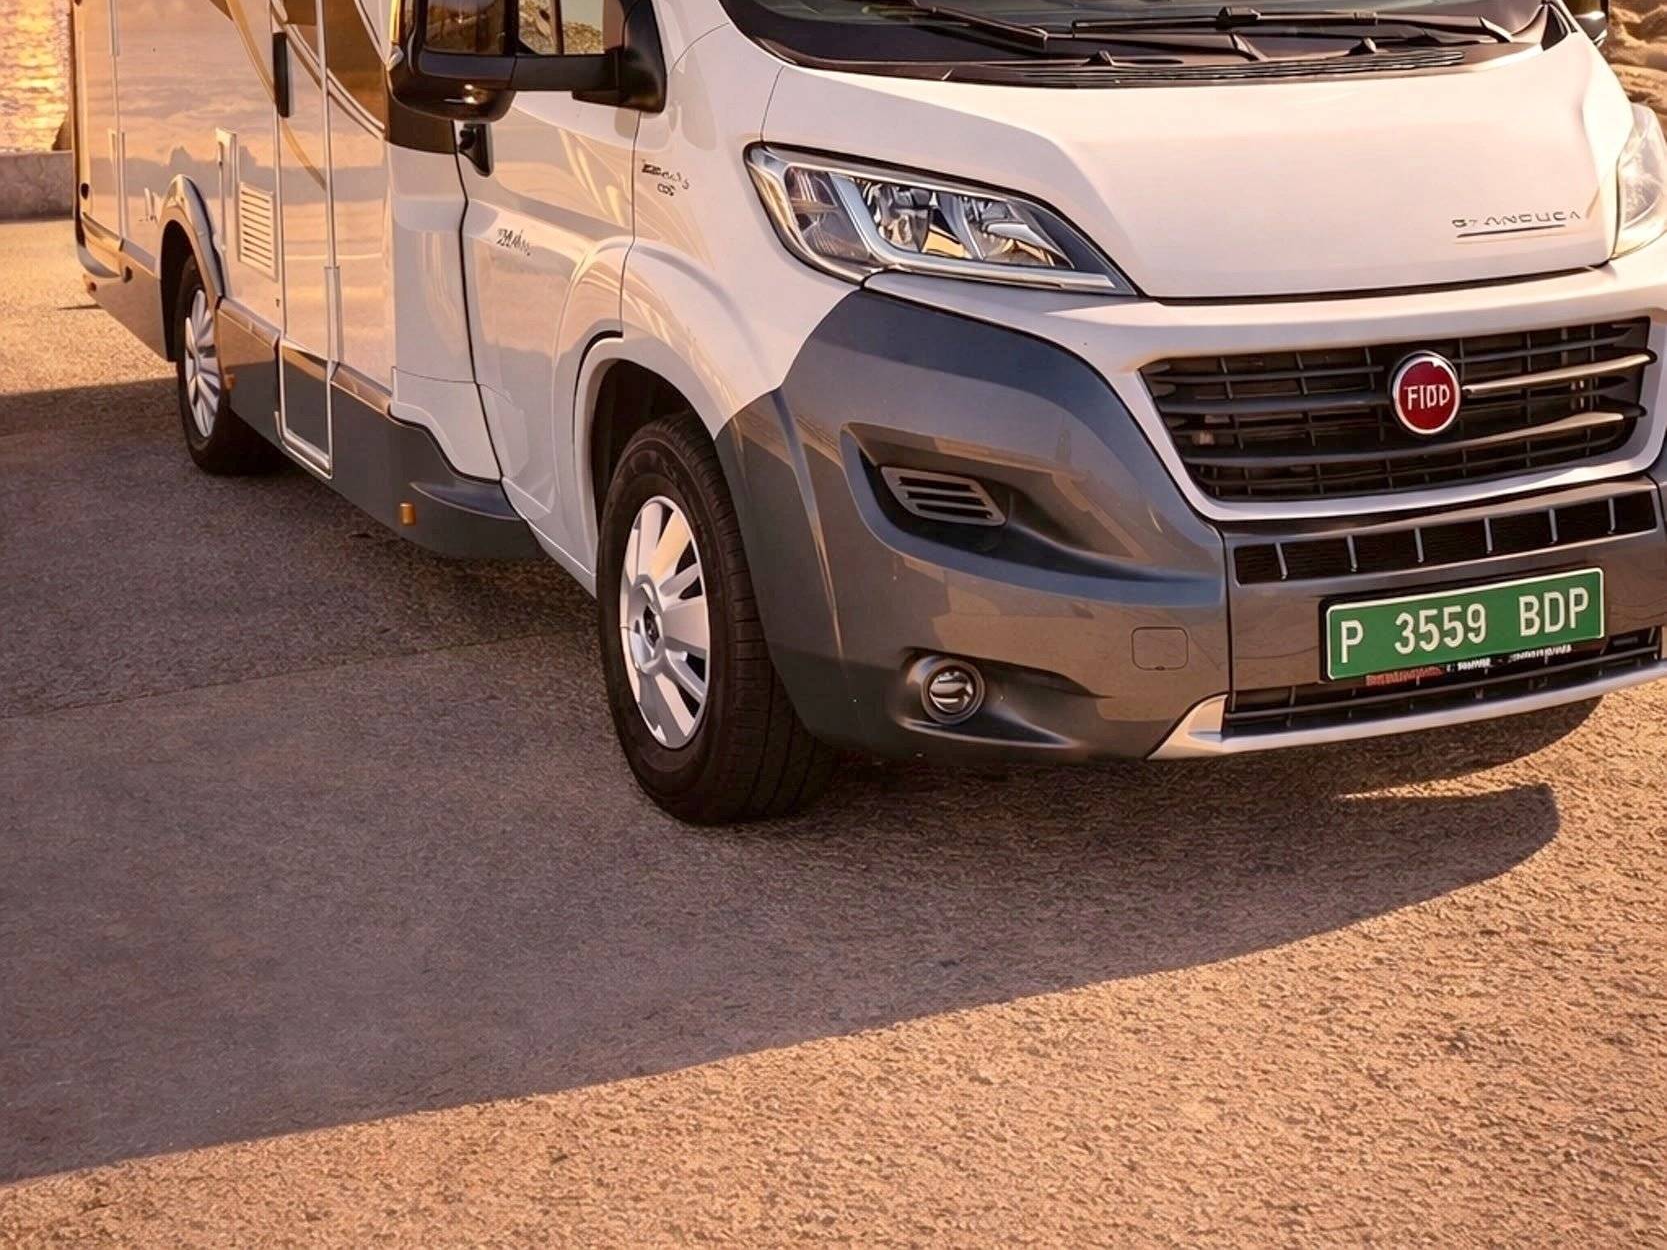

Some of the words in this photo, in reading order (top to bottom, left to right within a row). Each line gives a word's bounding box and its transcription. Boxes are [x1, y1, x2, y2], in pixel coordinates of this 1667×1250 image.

[1340, 619, 1364, 664] P
[1394, 603, 1487, 655] 3559
[1518, 586, 1589, 637] BDP
